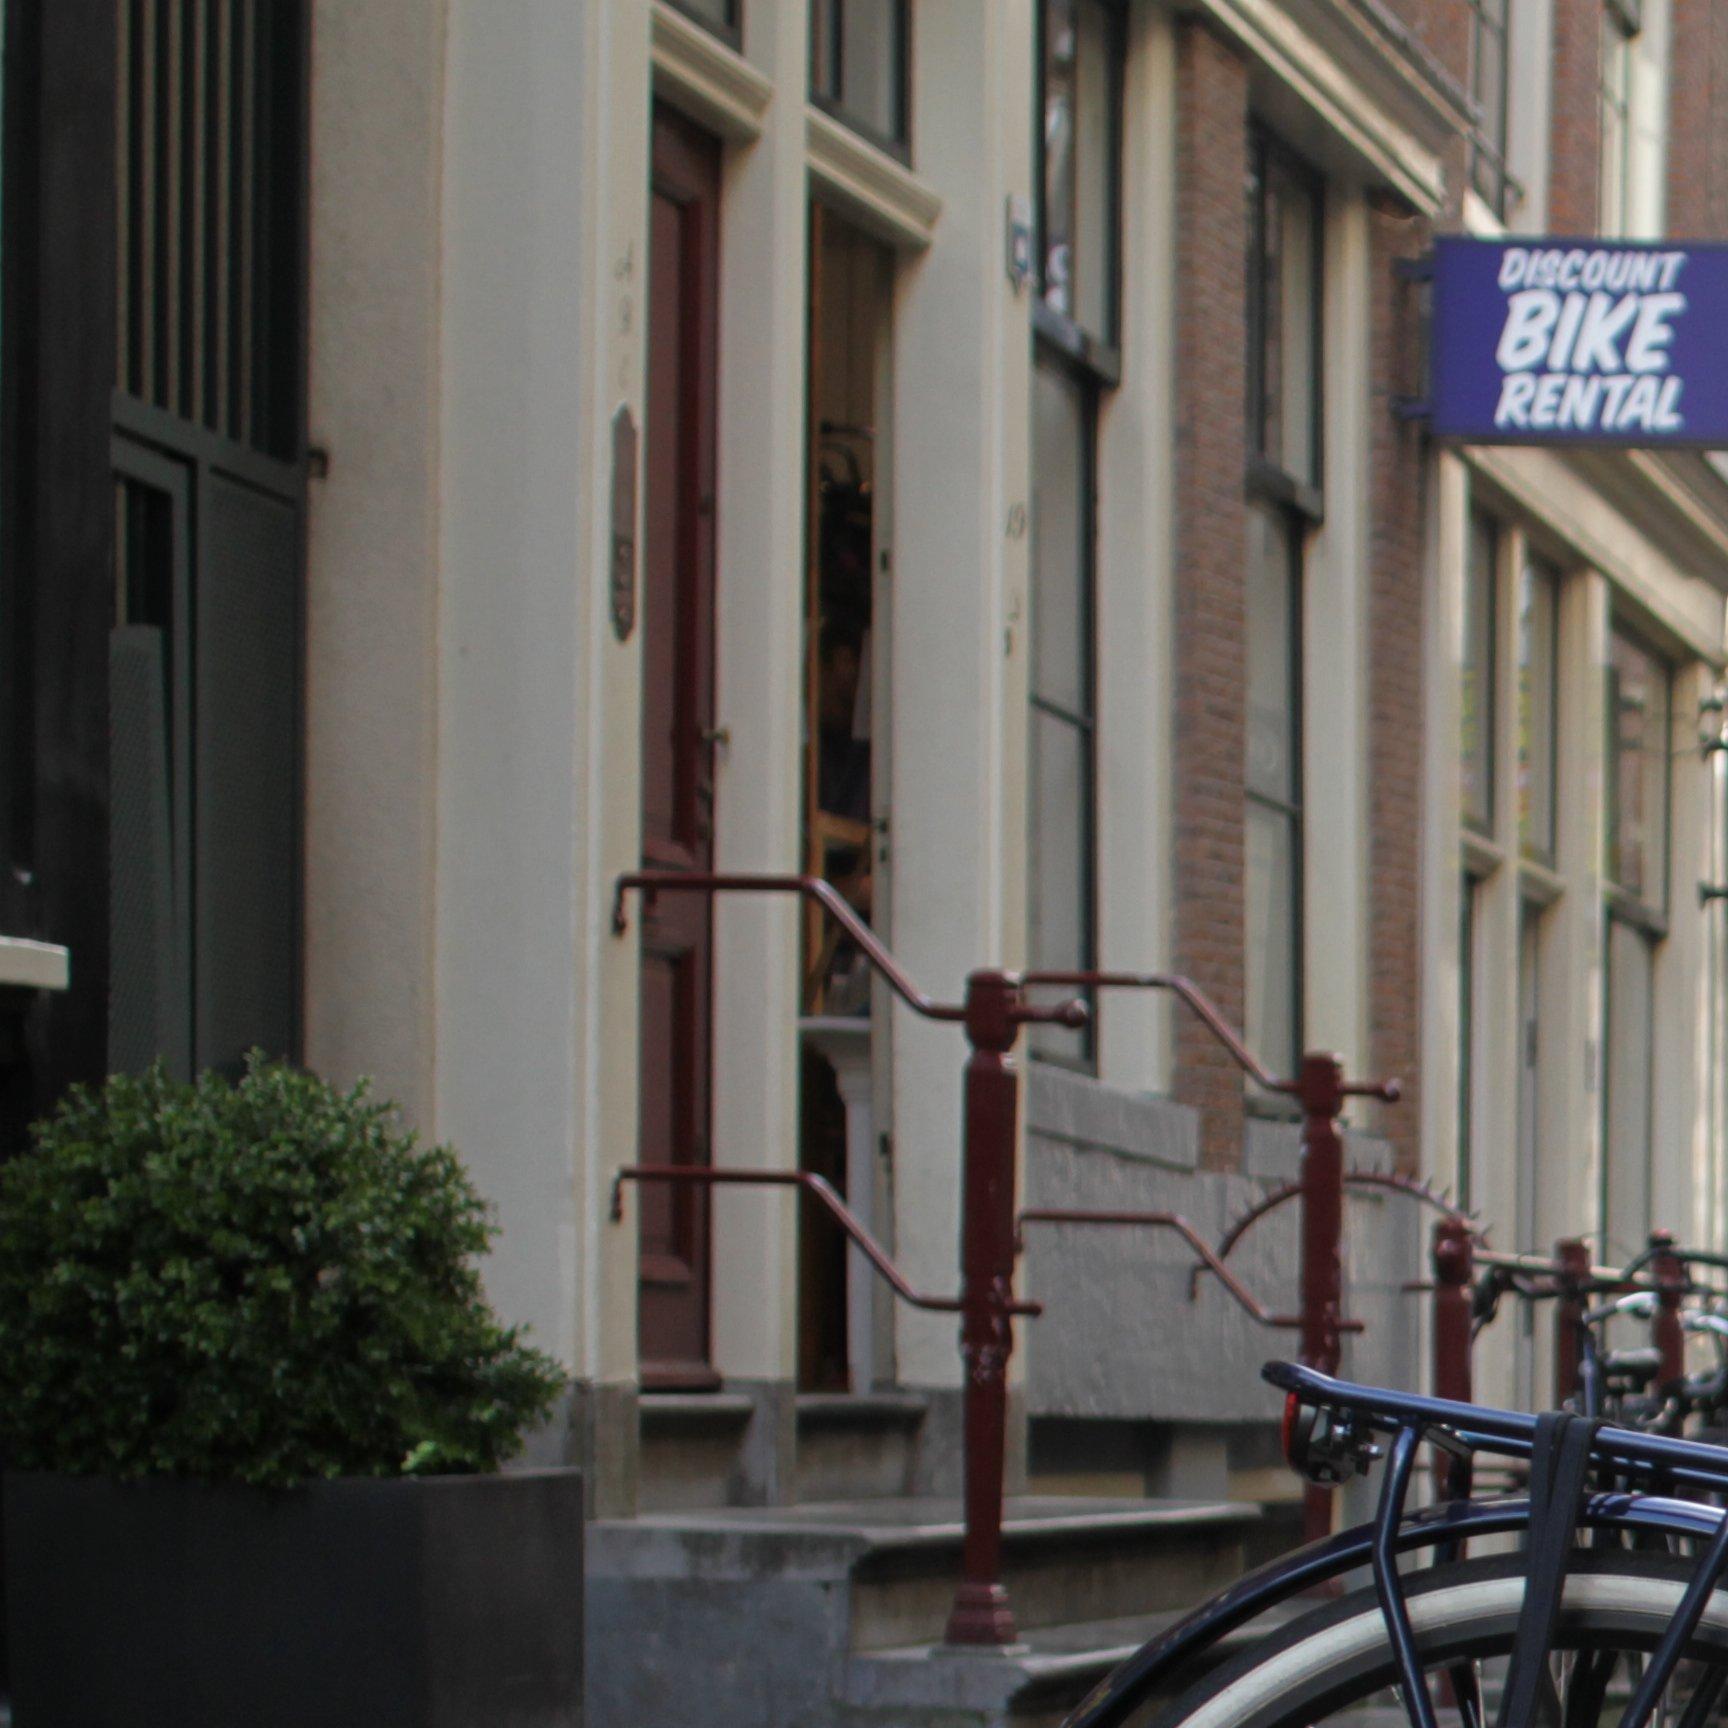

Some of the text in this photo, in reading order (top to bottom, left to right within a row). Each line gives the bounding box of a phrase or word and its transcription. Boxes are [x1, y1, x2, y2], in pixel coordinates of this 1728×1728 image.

[1498, 248, 1687, 290] DISCOUNT
[1495, 289, 1687, 373] BIKE
[1494, 373, 1684, 431] RENTAL
